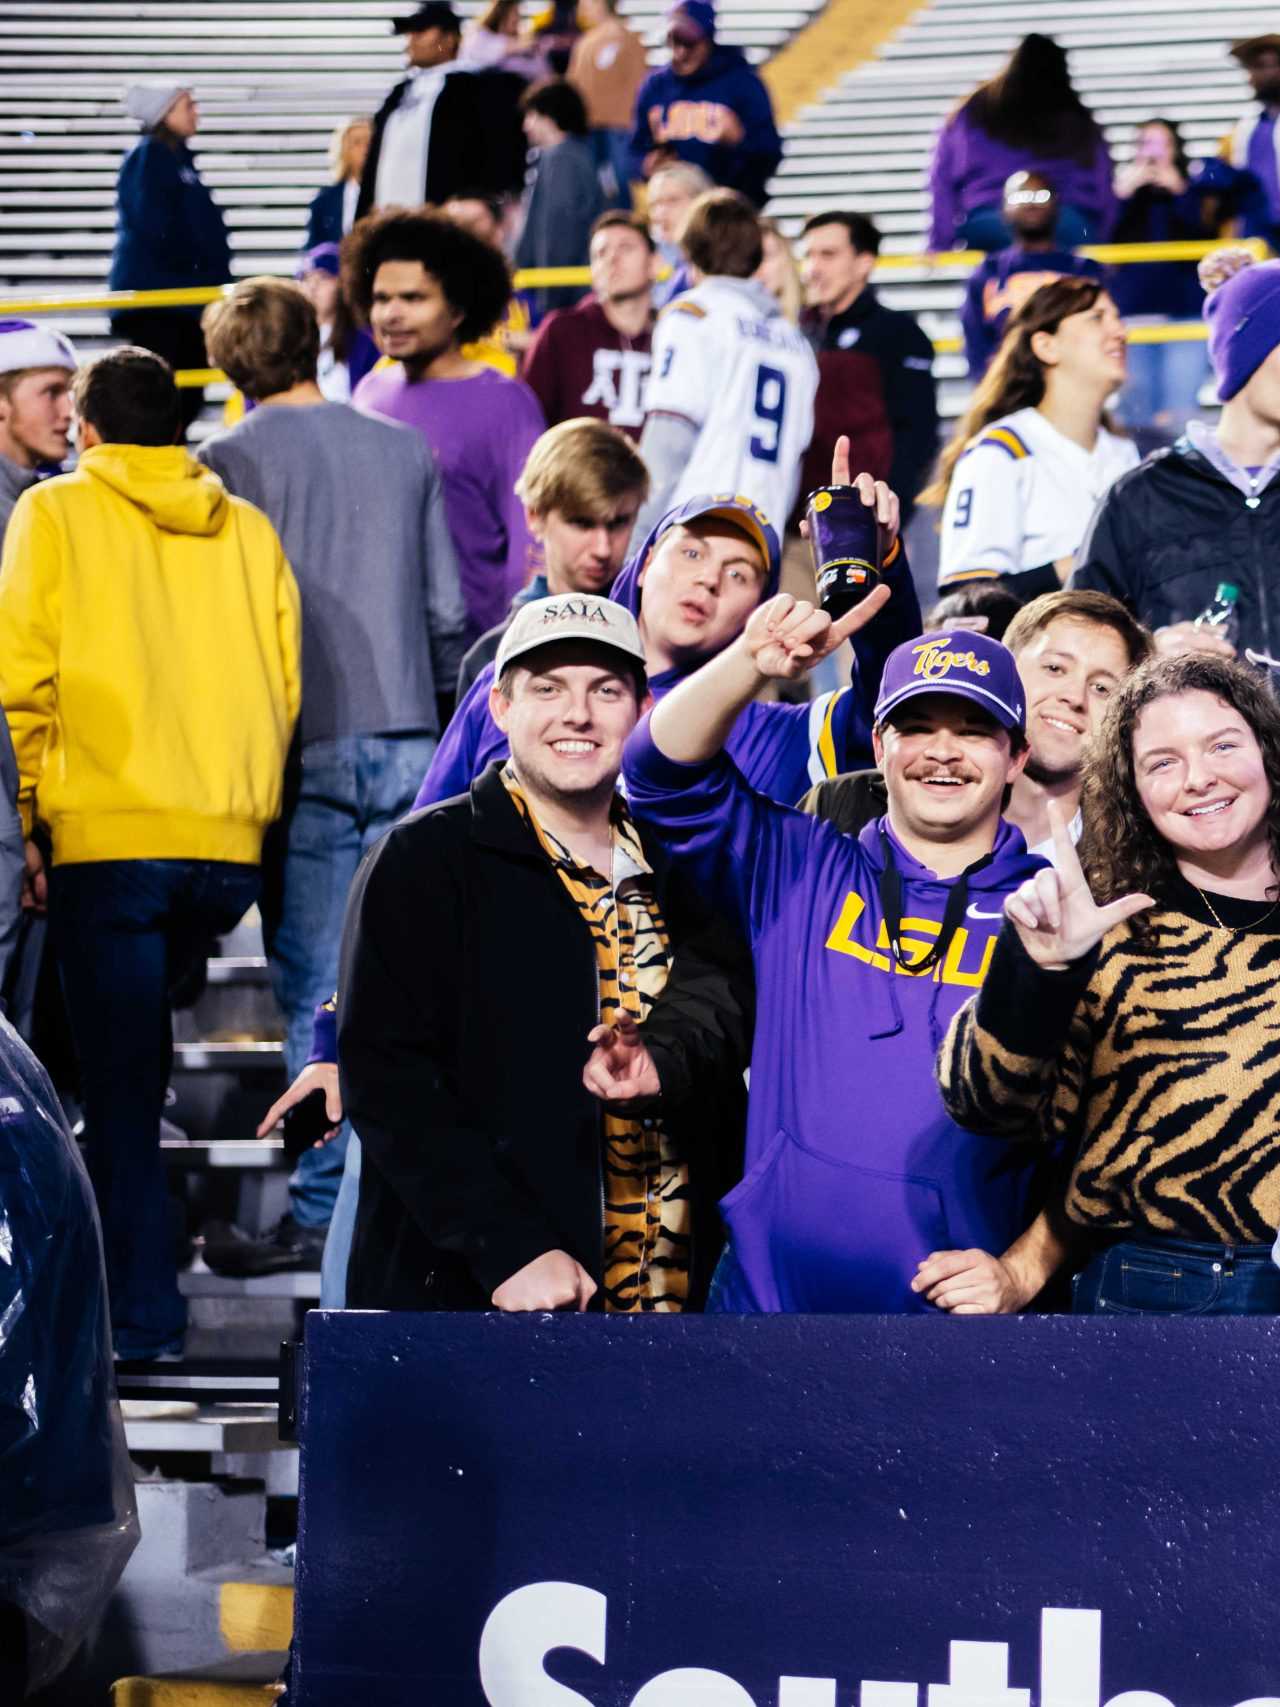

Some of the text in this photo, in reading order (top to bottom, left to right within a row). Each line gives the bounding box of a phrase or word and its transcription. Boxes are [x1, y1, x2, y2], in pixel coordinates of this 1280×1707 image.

[749, 363, 787, 463] 9
[953, 487, 974, 529] 9
[912, 638, 990, 679] Tigers
[825, 891, 998, 988] LSU
